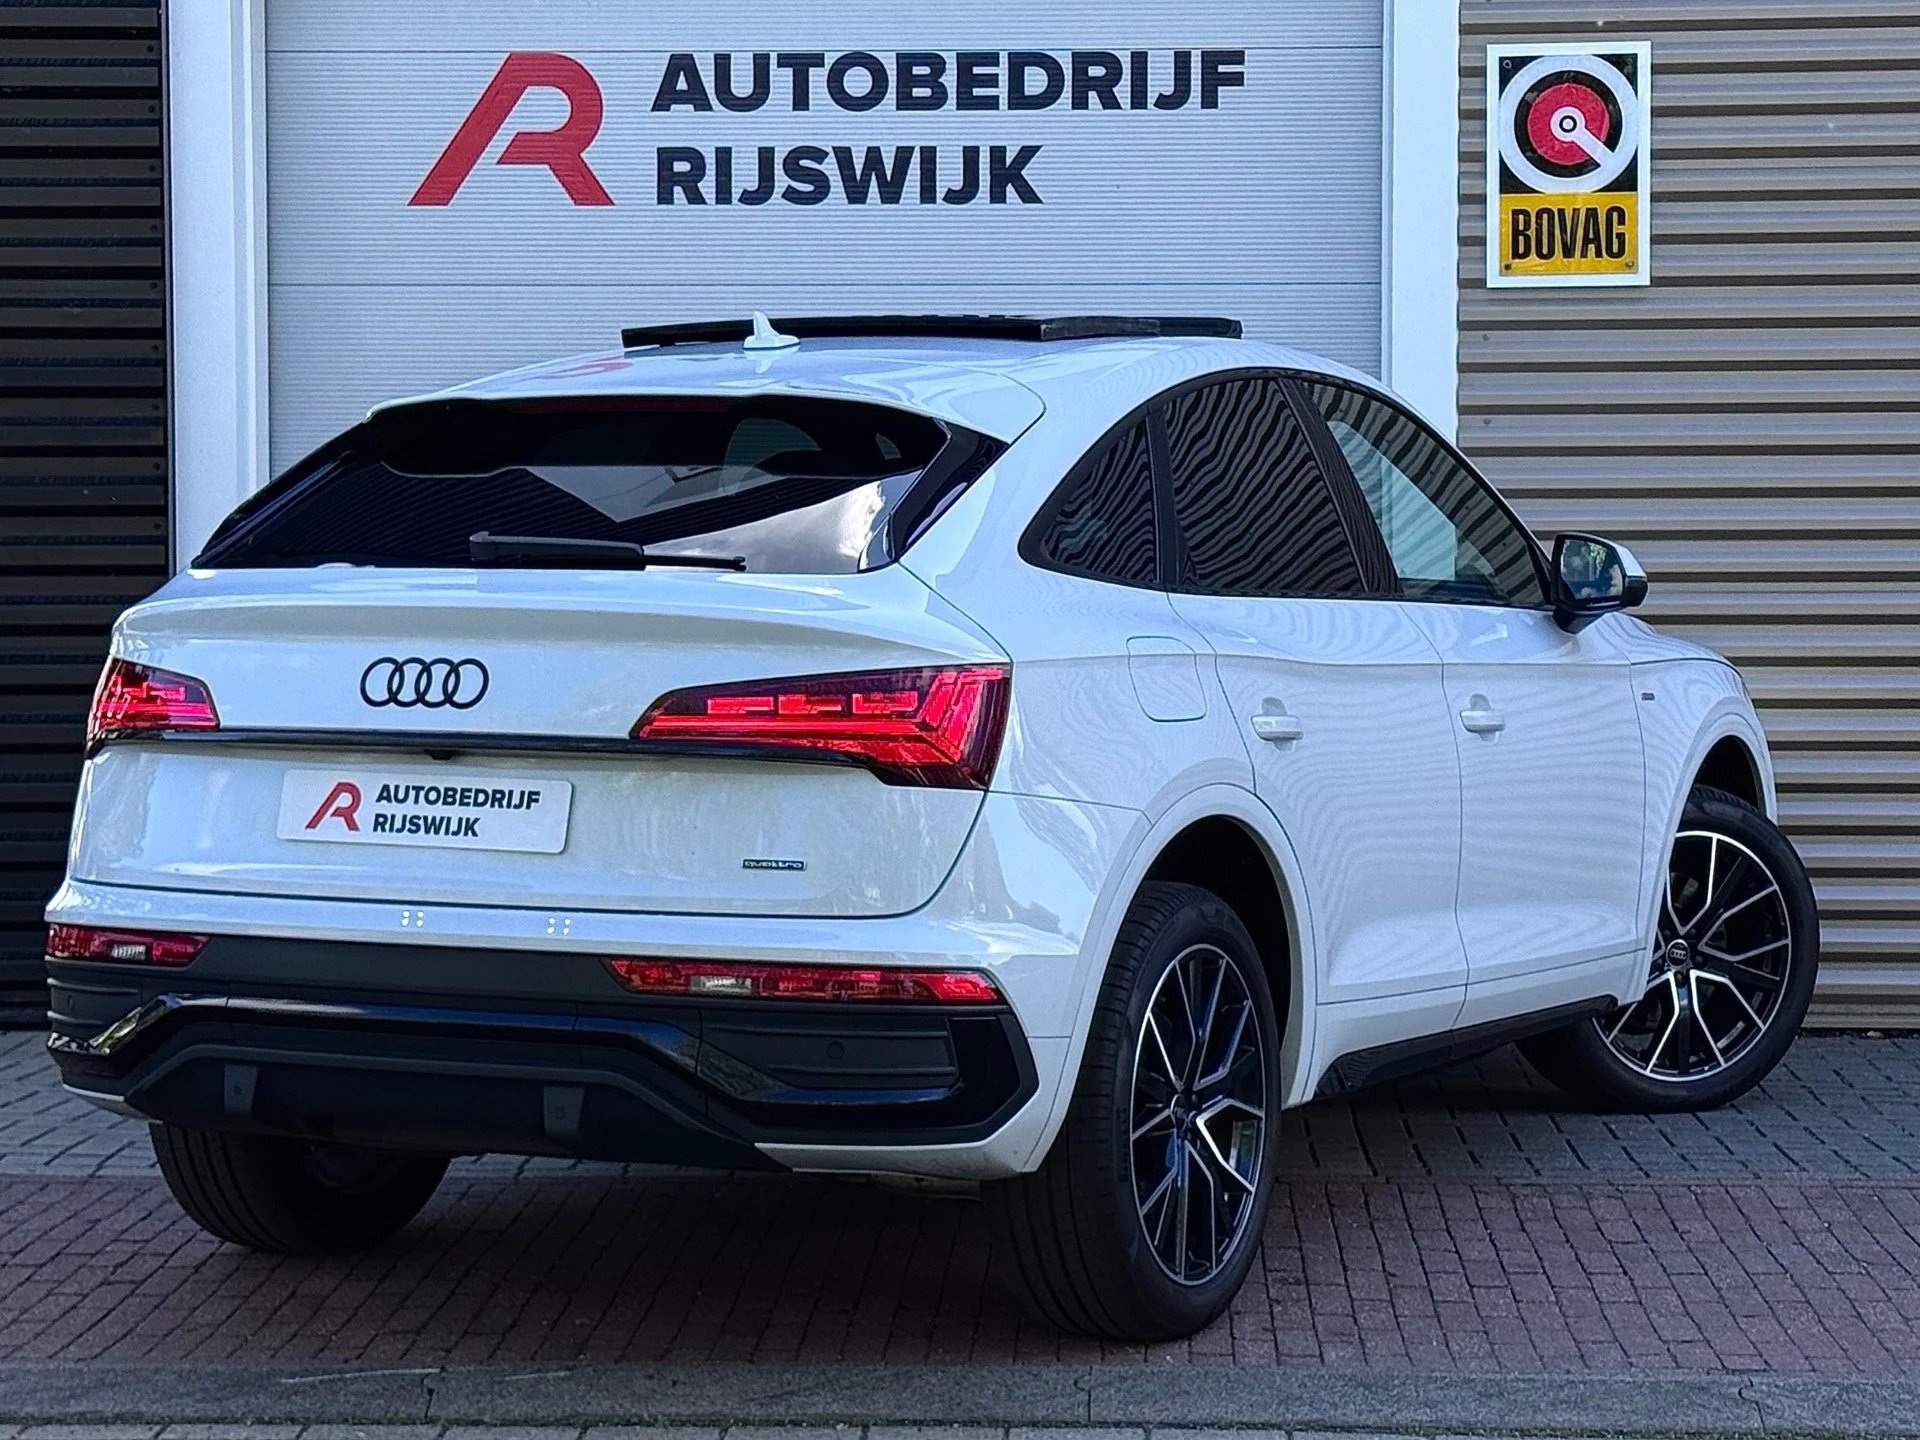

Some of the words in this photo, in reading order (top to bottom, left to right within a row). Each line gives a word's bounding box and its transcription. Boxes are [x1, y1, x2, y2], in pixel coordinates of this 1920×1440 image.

[651, 50, 1246, 113] AUTOBEDRIJF
[656, 146, 1044, 206] RIJSWIJK
[1511, 206, 1627, 261] BOVAG
[375, 783, 542, 811] AUTOBEDRIJF
[372, 813, 481, 838] RIJSWIJK
[744, 860, 803, 869] quattro
